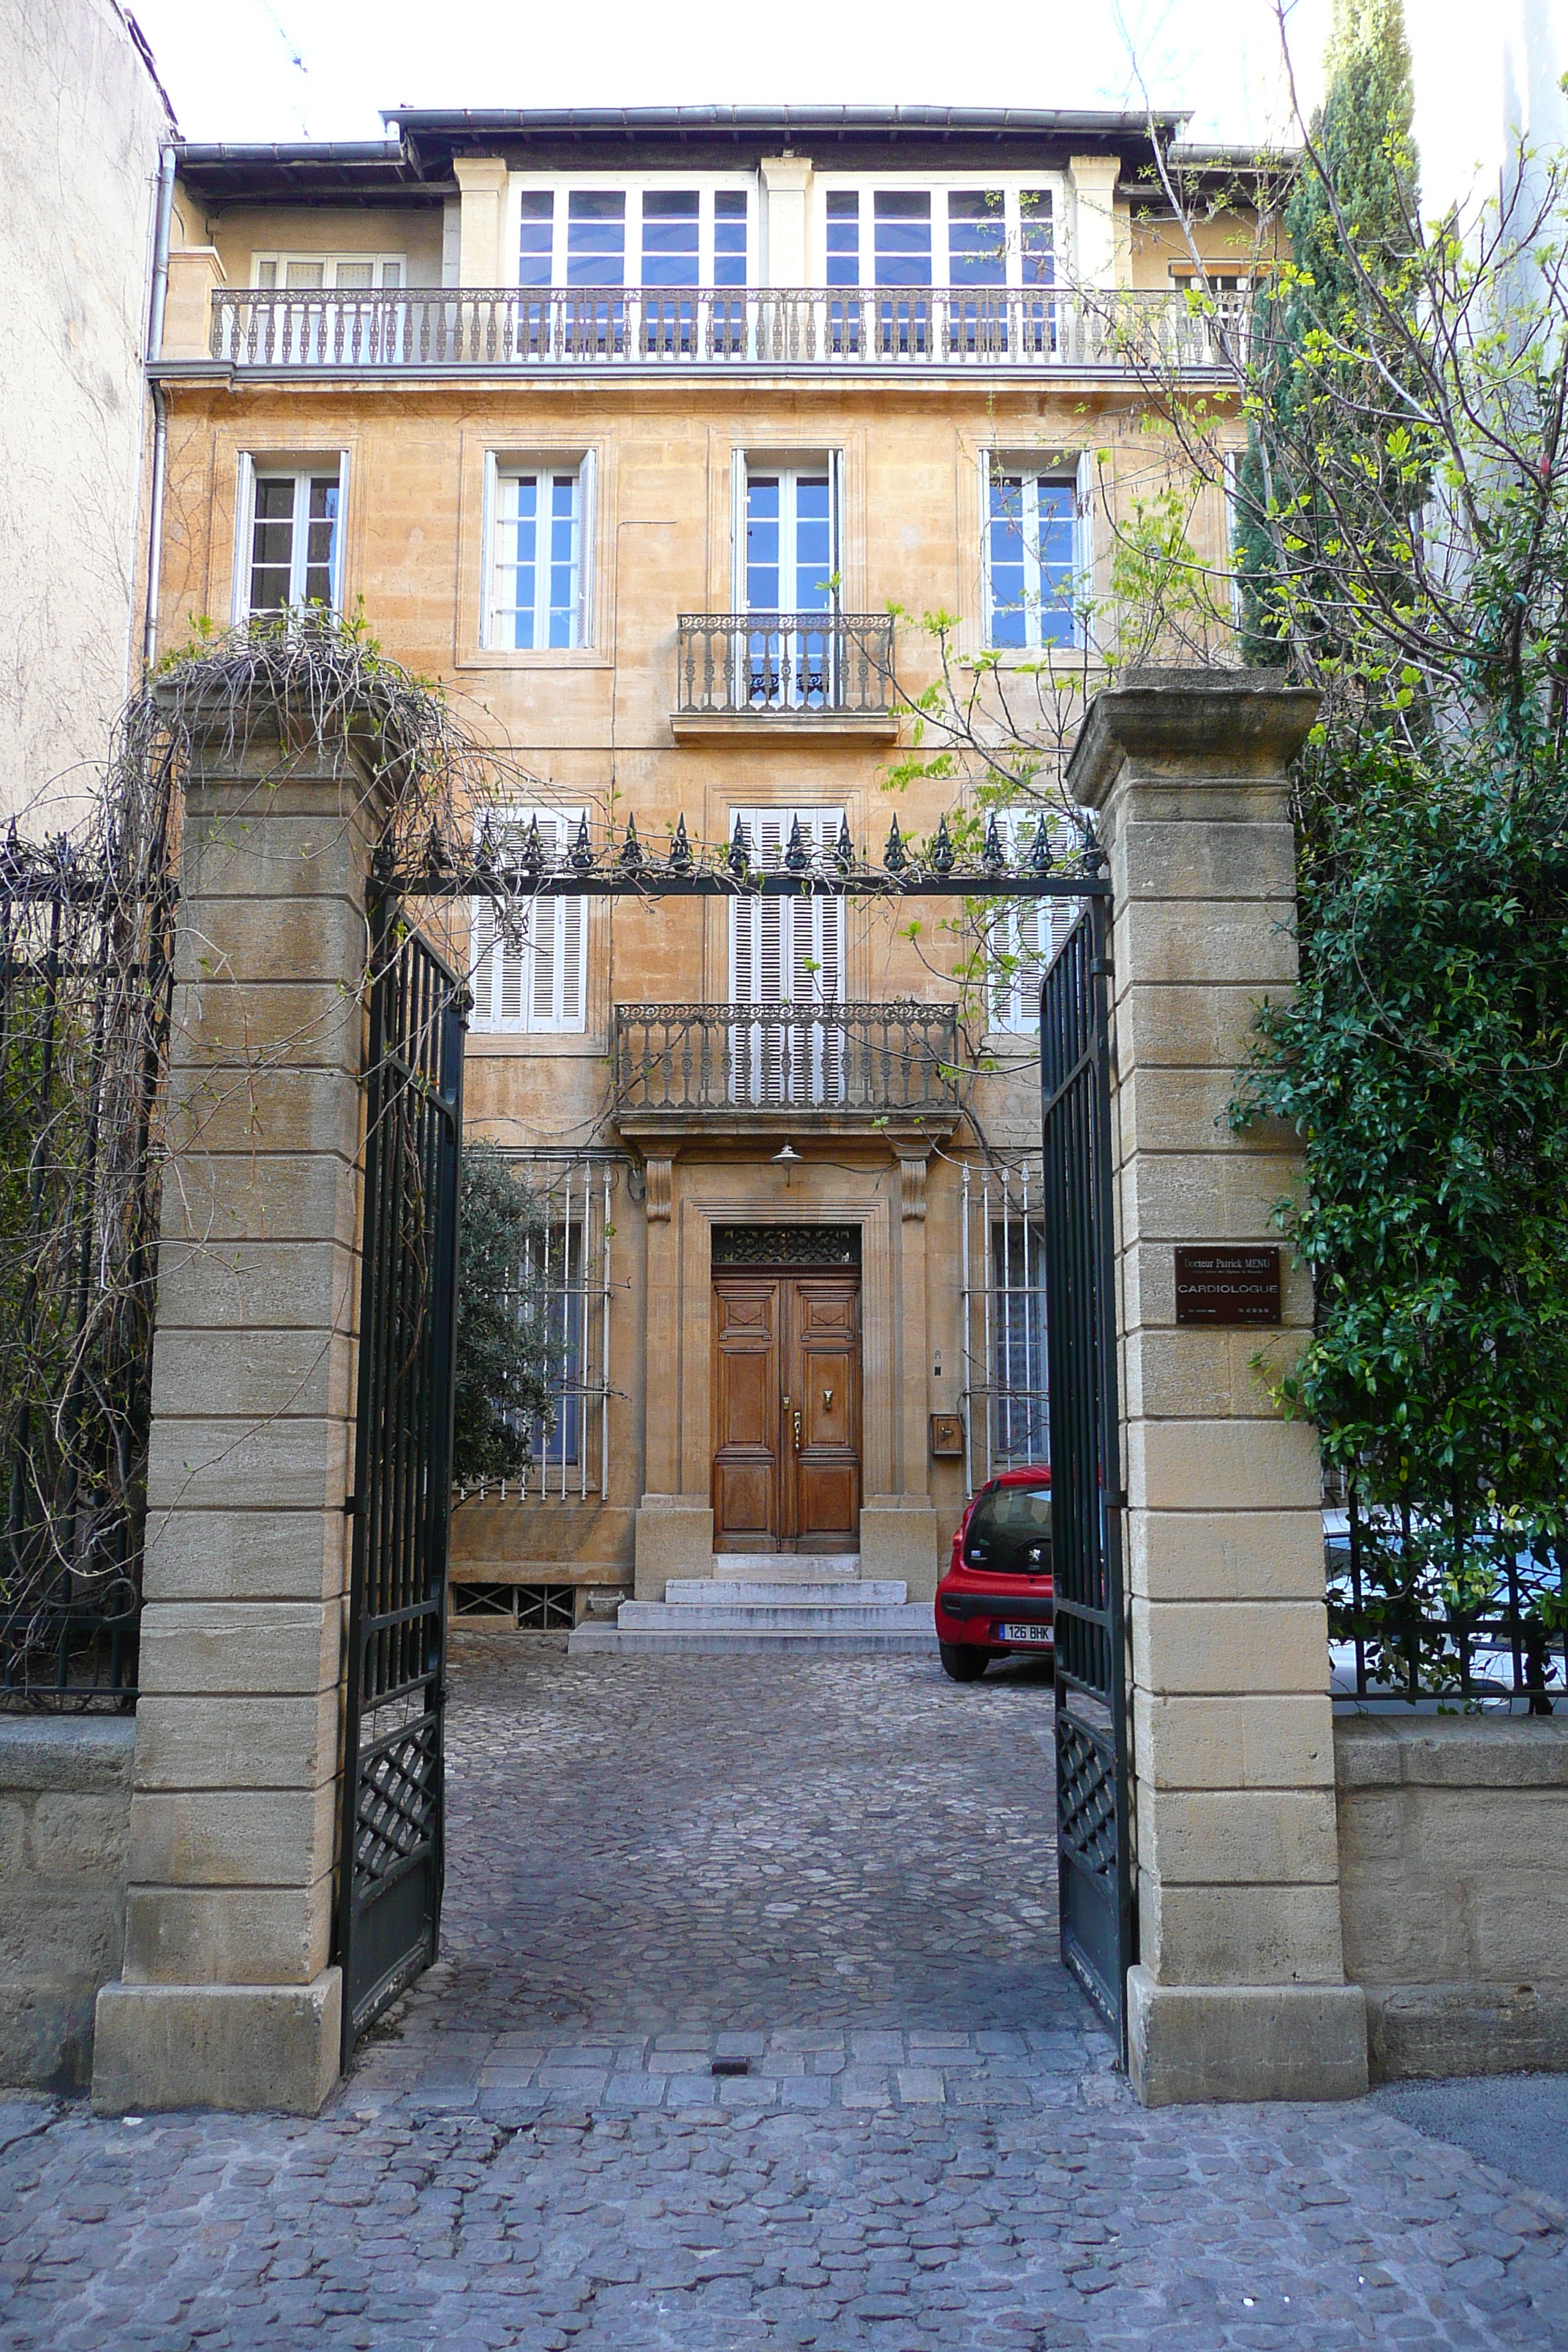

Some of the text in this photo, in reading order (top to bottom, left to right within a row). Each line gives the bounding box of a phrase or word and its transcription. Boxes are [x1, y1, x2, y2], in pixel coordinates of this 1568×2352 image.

[1185, 1259, 1270, 1268] Docteur Patrick MENU
[1177, 1285, 1278, 1293] CARDIOLOGUE
[1009, 1626, 1049, 1639] 126 BHK
